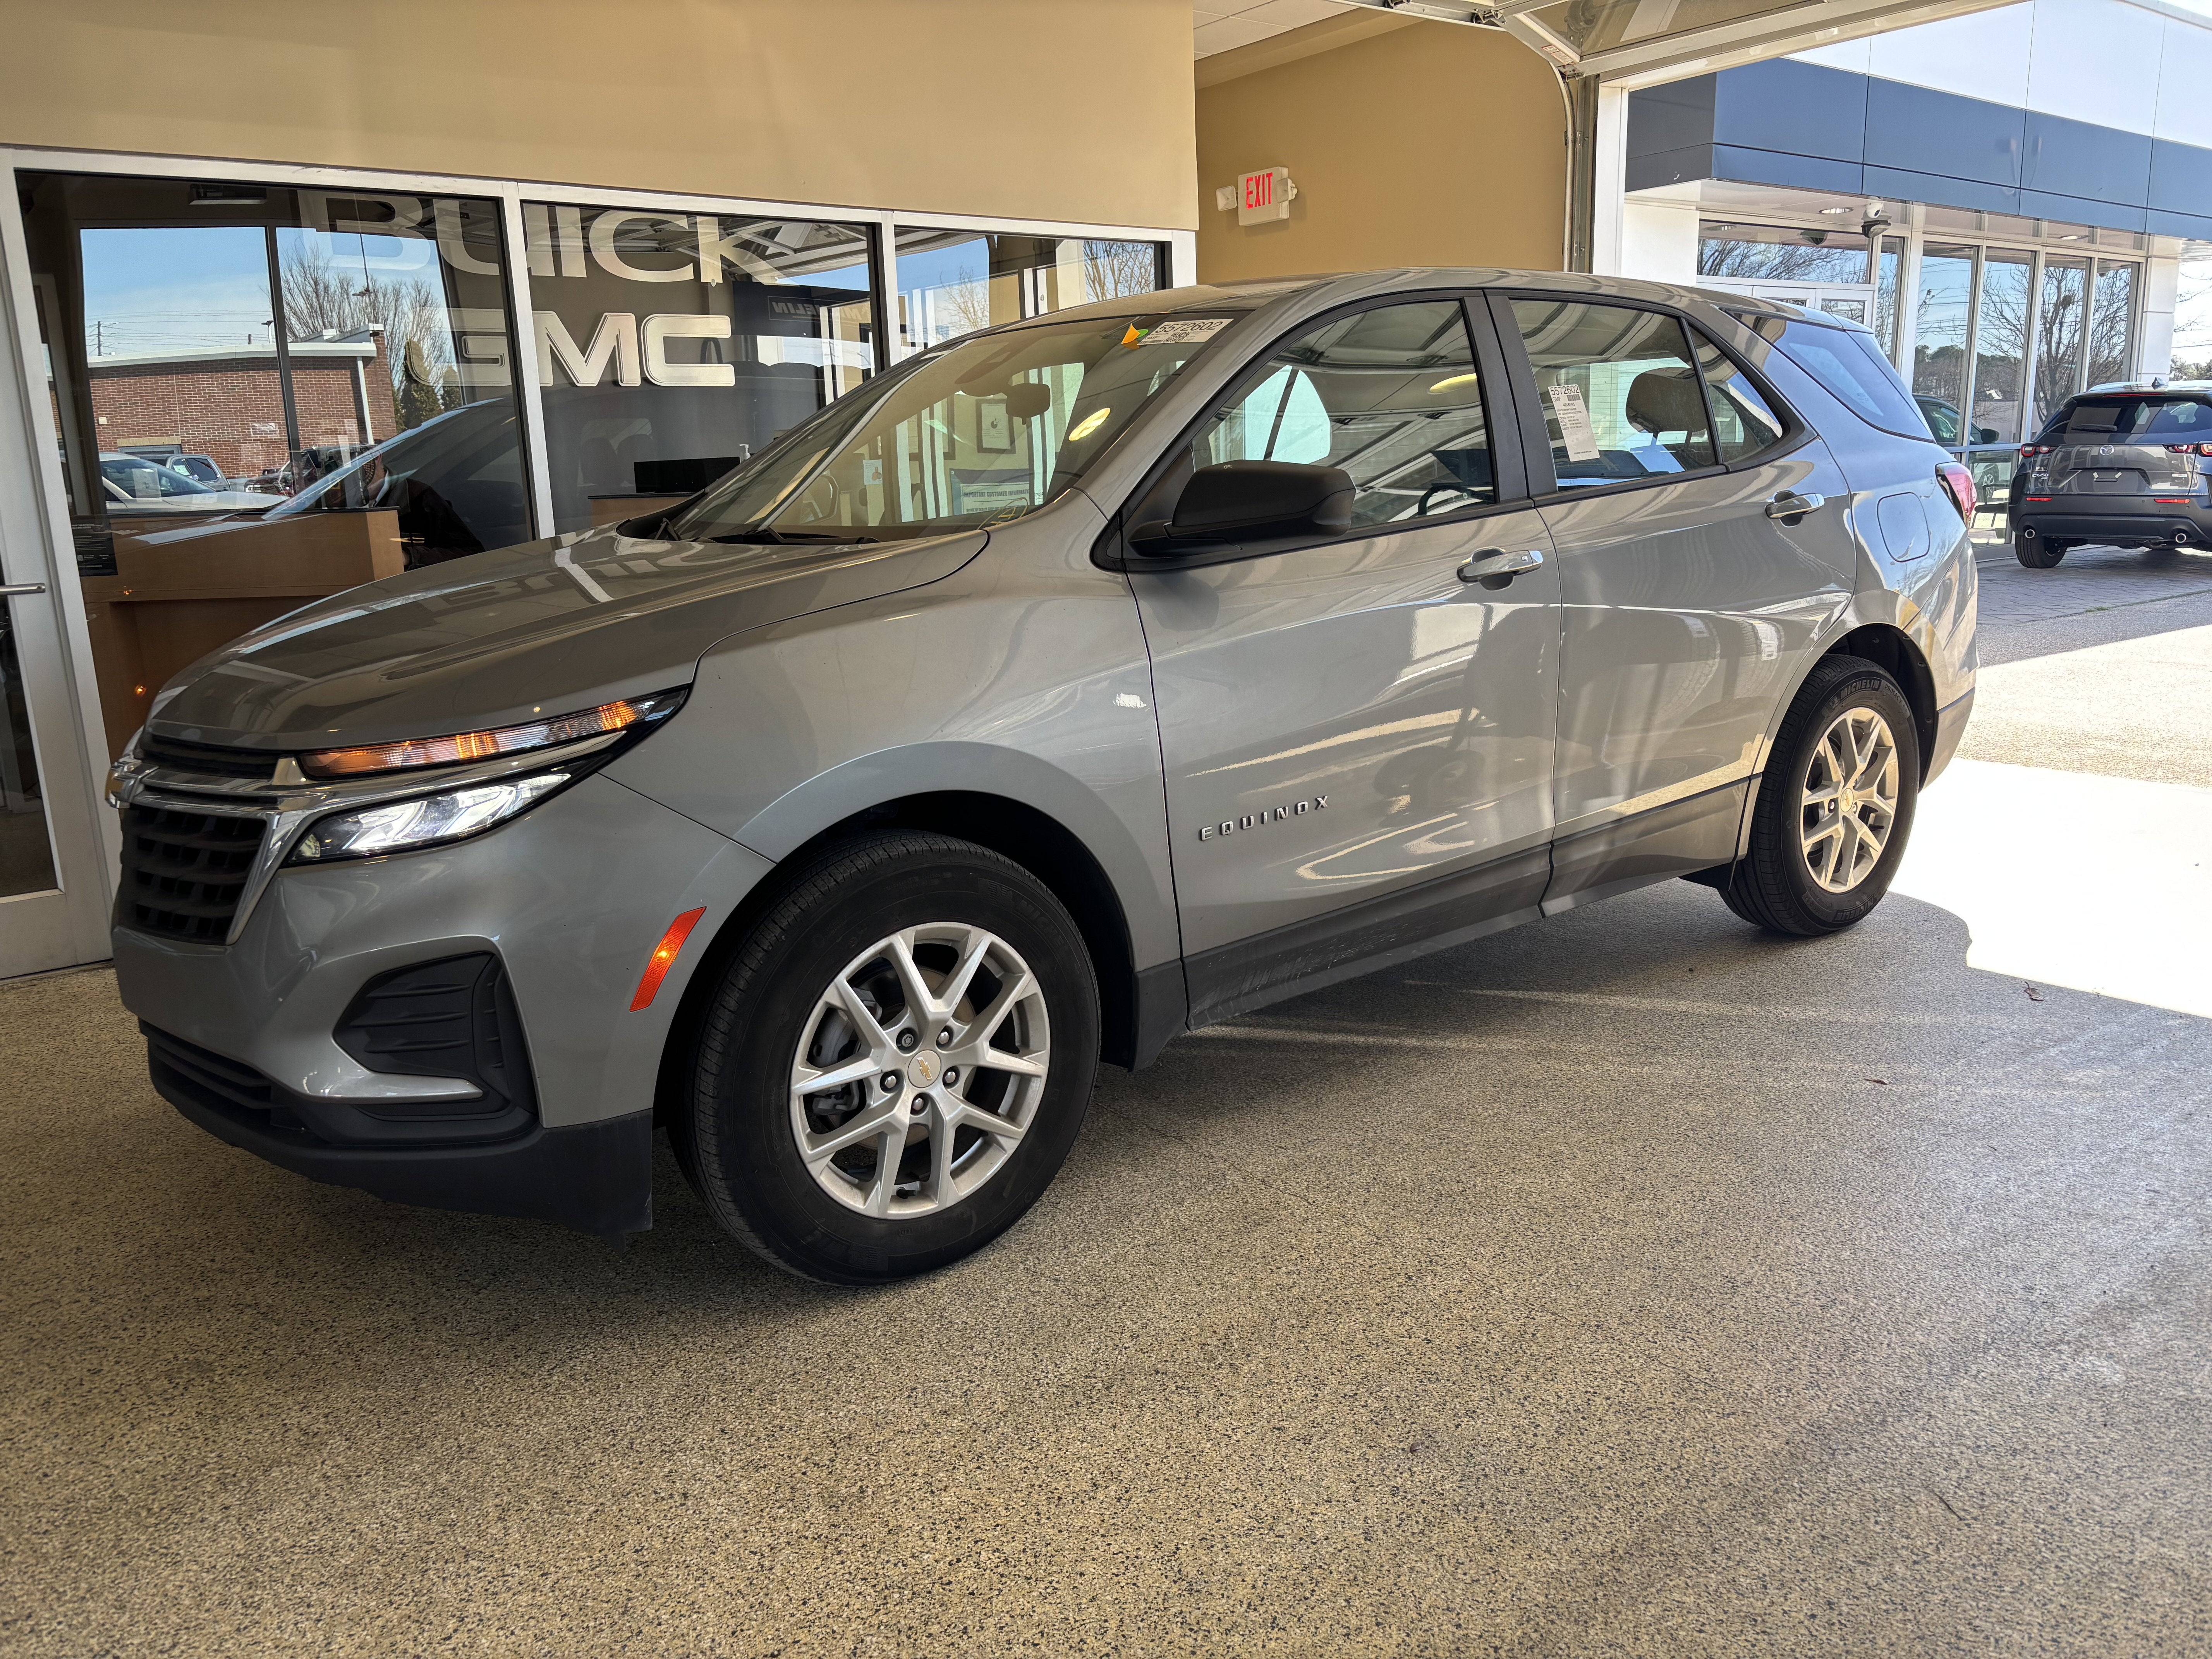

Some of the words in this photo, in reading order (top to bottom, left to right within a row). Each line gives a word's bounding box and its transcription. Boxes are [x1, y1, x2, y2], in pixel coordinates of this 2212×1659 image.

[1246, 172, 1273, 210] EXIT
[297, 190, 800, 285] BUICK
[1155, 321, 1223, 333] 5572602
[405, 307, 736, 386] GMC
[1551, 385, 1580, 395] 5572602
[1840, 680, 1880, 699] MICHELIN
[1884, 684, 1903, 704] PRIMACY
[1198, 795, 1328, 841] EQUINOX
